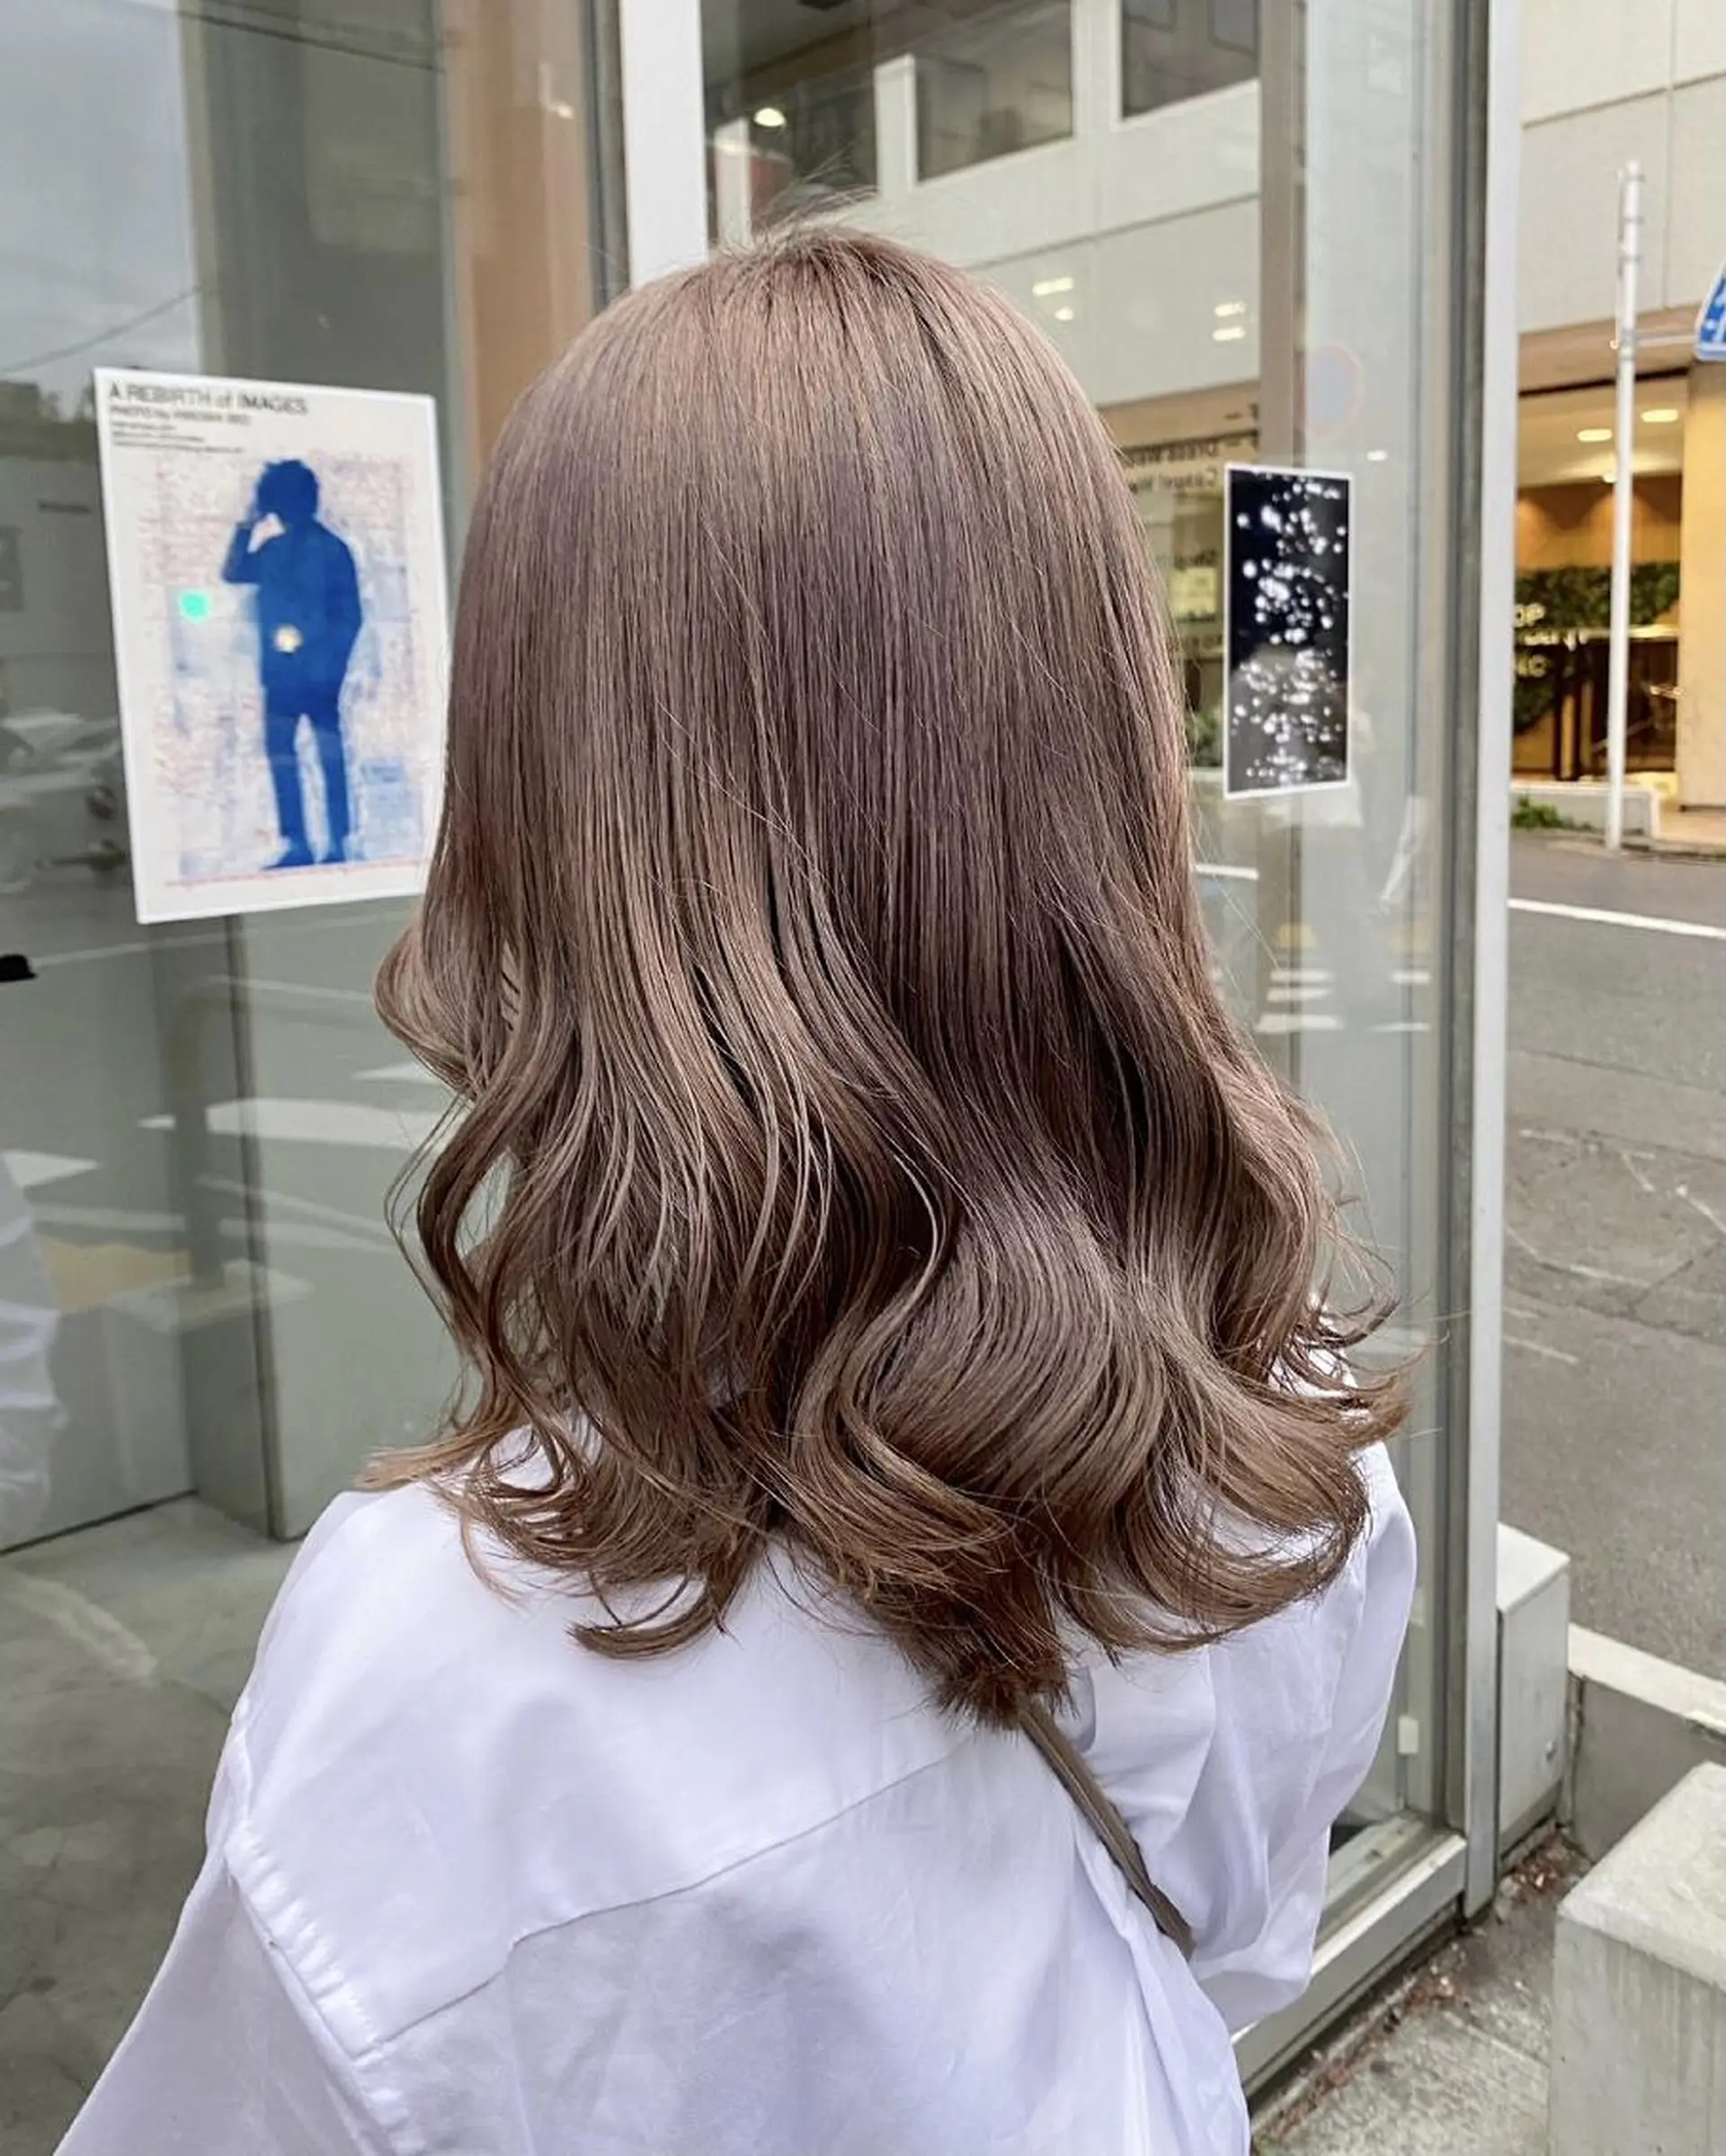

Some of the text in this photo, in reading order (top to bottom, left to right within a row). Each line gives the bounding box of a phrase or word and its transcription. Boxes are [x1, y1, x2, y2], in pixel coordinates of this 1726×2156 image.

[109, 382, 122, 398] A
[128, 384, 211, 406] REBIRTH
[237, 393, 309, 415] IMAGES
